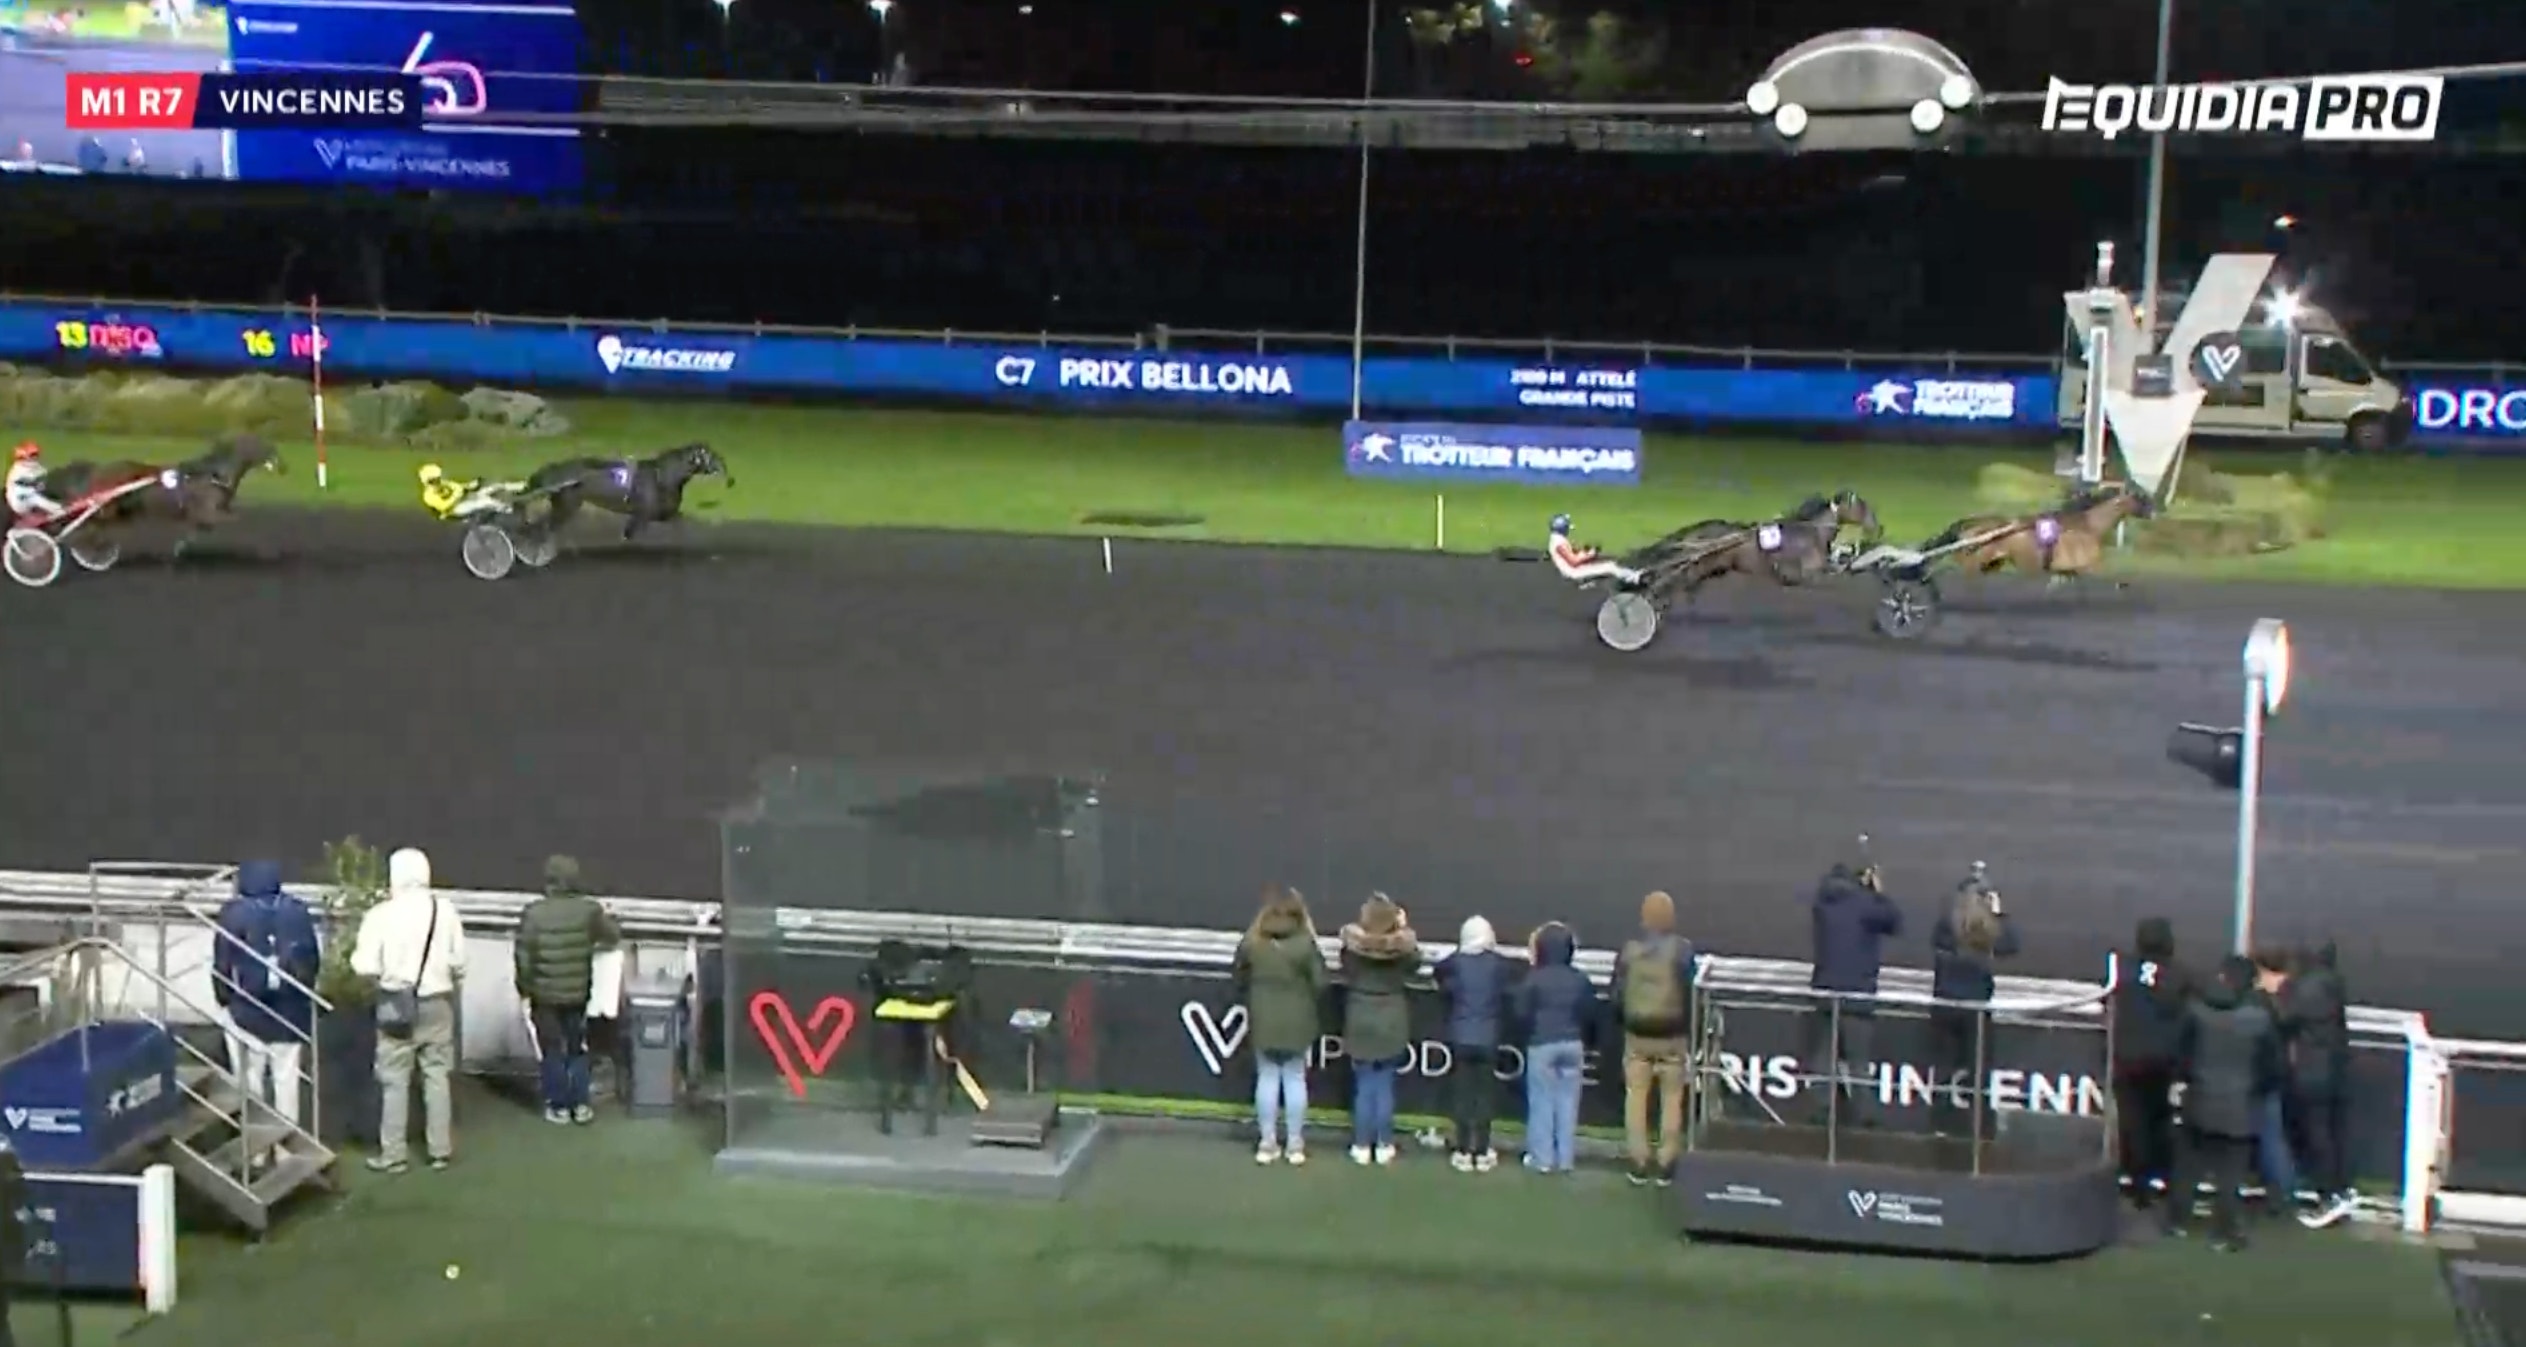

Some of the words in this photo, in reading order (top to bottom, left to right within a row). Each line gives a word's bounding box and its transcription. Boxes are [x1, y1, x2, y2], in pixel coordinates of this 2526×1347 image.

[56, 321, 87, 348] 13
[242, 329, 275, 357] 16
[995, 355, 1036, 386] C7
[1060, 358, 1135, 389] PRIX
[1141, 361, 1293, 395] BELLONA
[2412, 388, 2526, 429] DRO
[1401, 443, 1512, 468] TROTTEUR
[1517, 445, 1636, 474] FRANÇAIS
